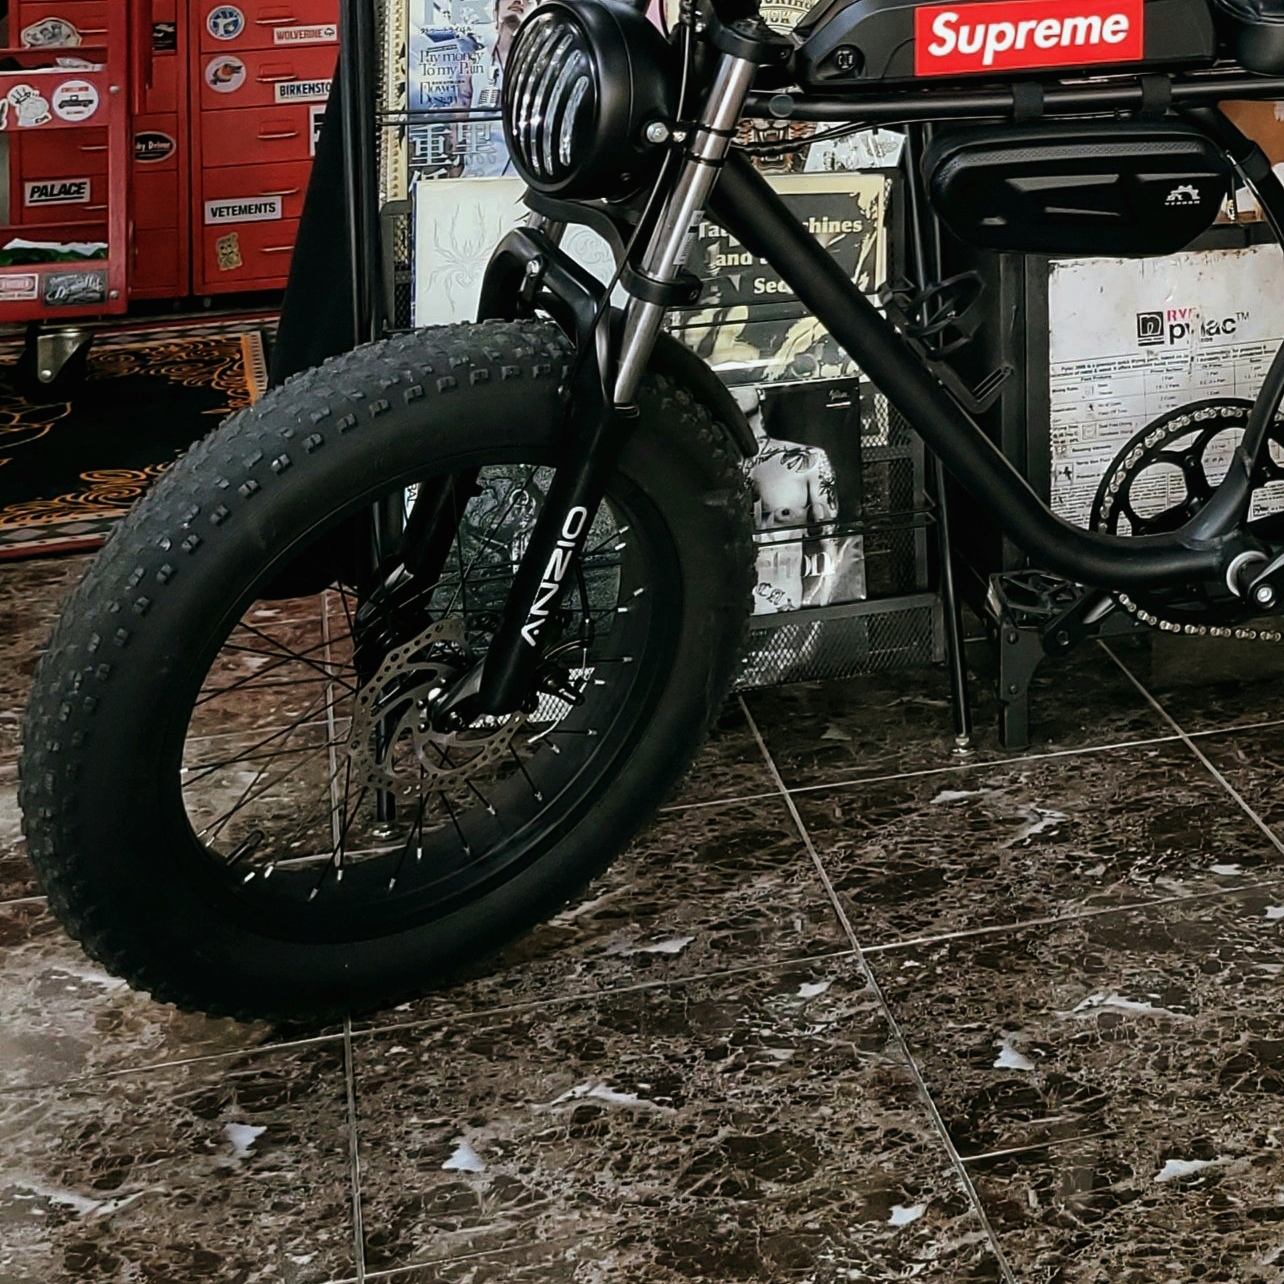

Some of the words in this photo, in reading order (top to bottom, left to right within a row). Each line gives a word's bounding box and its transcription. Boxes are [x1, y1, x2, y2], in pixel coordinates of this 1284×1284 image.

[926, 9, 1130, 66] Supreme
[279, 81, 332, 96] BIRKENSTO
[29, 182, 87, 199] PALACE
[210, 202, 276, 218] VETEMENTS
[801, 216, 863, 234] hines
[717, 252, 753, 267] and
